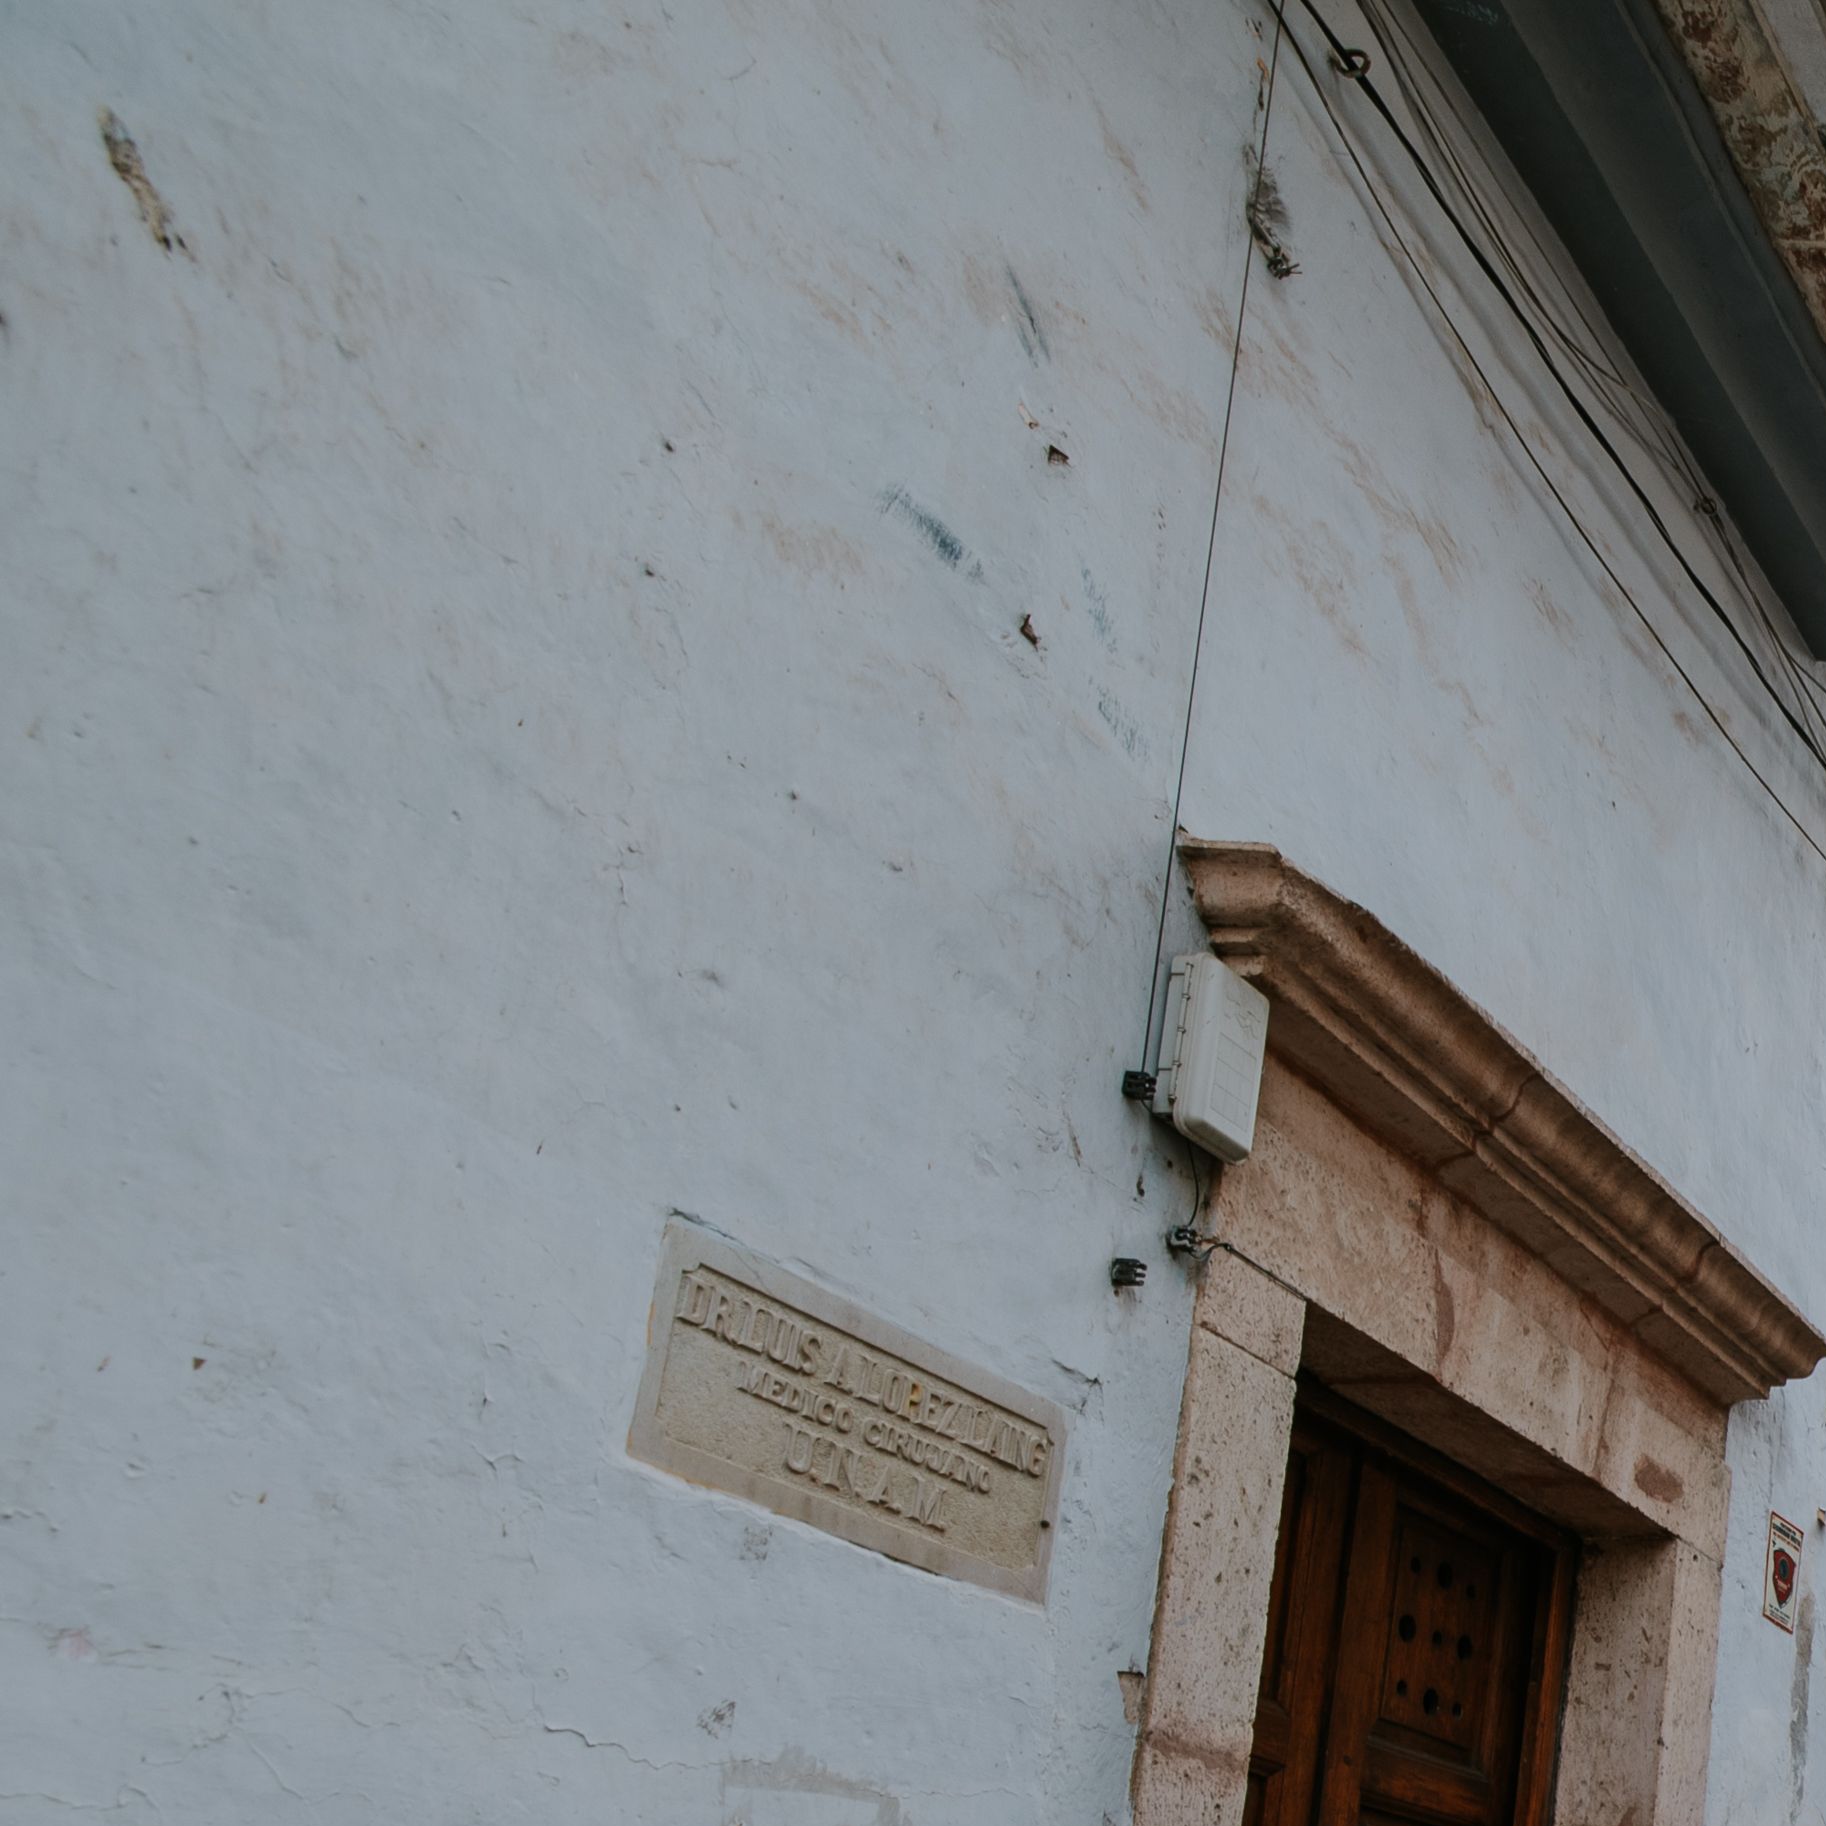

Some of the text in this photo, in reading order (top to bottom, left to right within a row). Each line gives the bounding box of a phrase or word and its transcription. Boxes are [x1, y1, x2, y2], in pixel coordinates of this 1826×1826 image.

[737, 1359, 991, 1494] MEDICO CIRUJANO
[738, 1299, 822, 1376] LUIS
[853, 1354, 961, 1440] LOPEZ
[957, 1402, 1049, 1478] LAING
